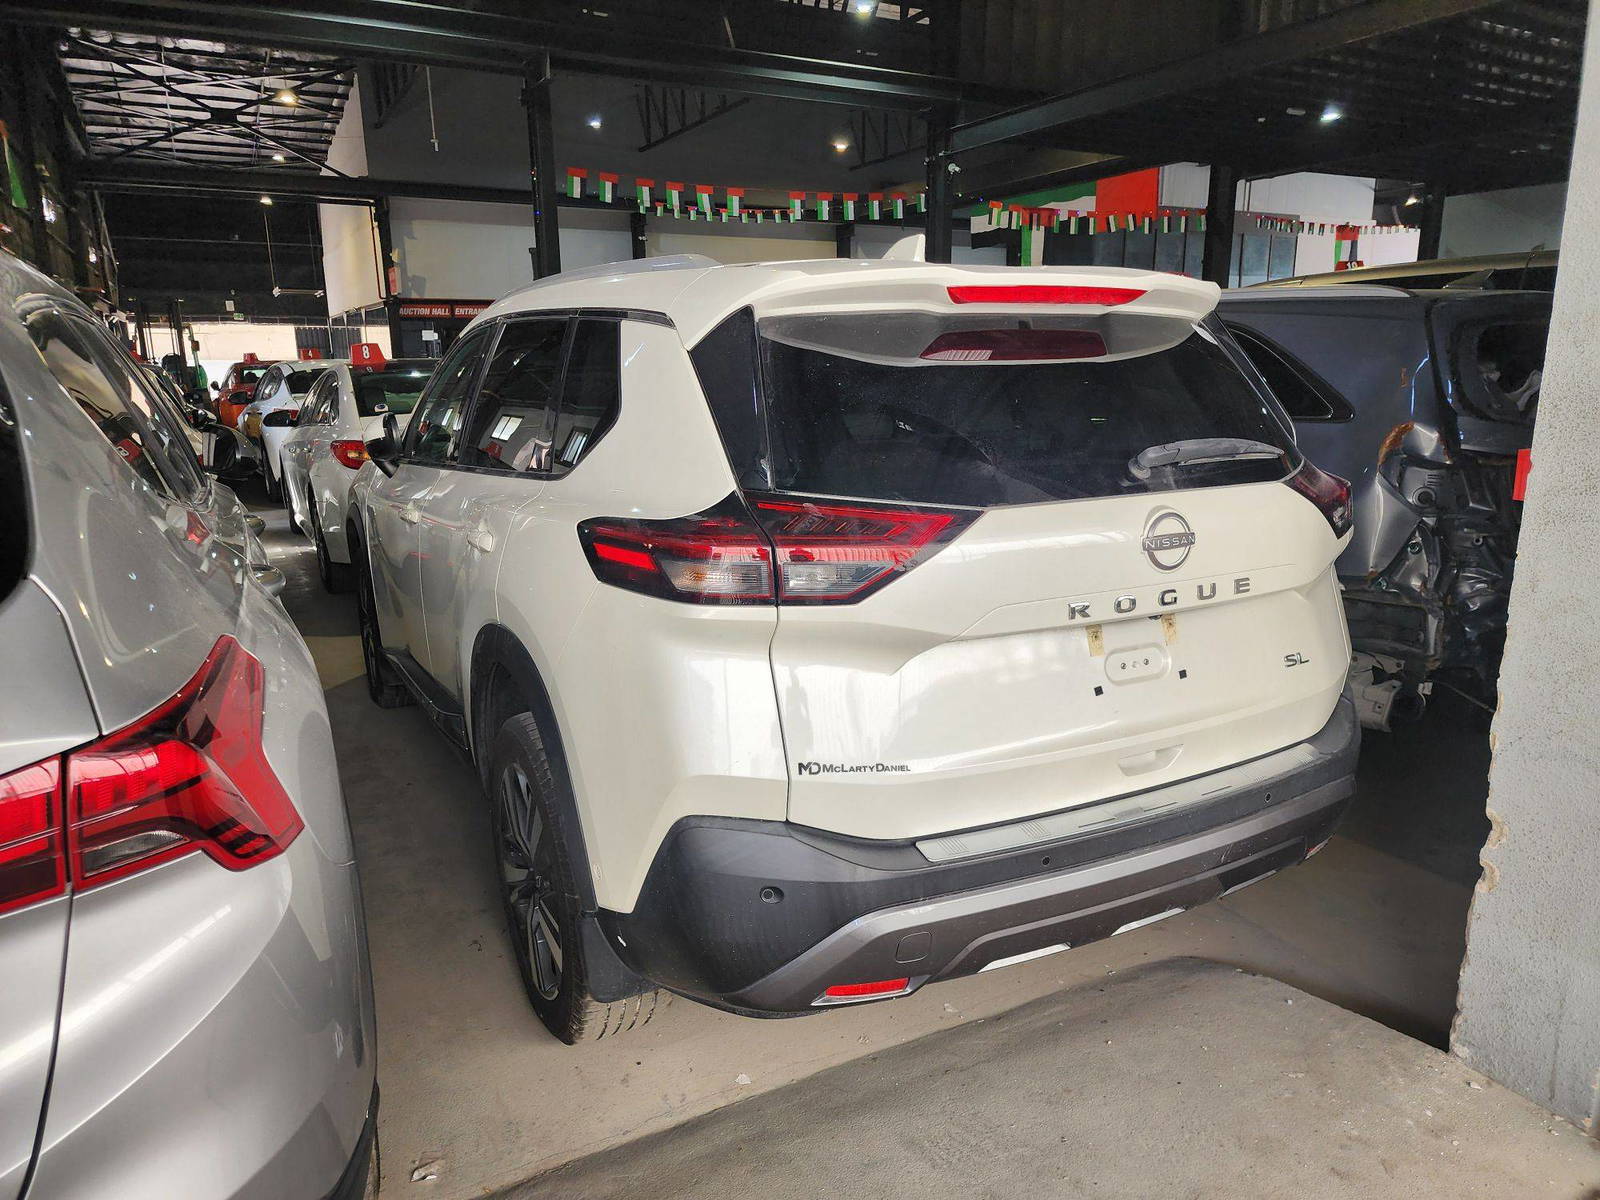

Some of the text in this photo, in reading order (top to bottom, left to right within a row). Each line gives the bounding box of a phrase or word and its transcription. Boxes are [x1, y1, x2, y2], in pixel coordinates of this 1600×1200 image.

[399, 307, 450, 316] AUCTION HALL
[455, 307, 487, 316] ENTRAN
[362, 345, 370, 359] 8
[1144, 533, 1196, 549] NISSAN
[1067, 577, 1251, 620] ROGUE
[1283, 652, 1310, 668] SL
